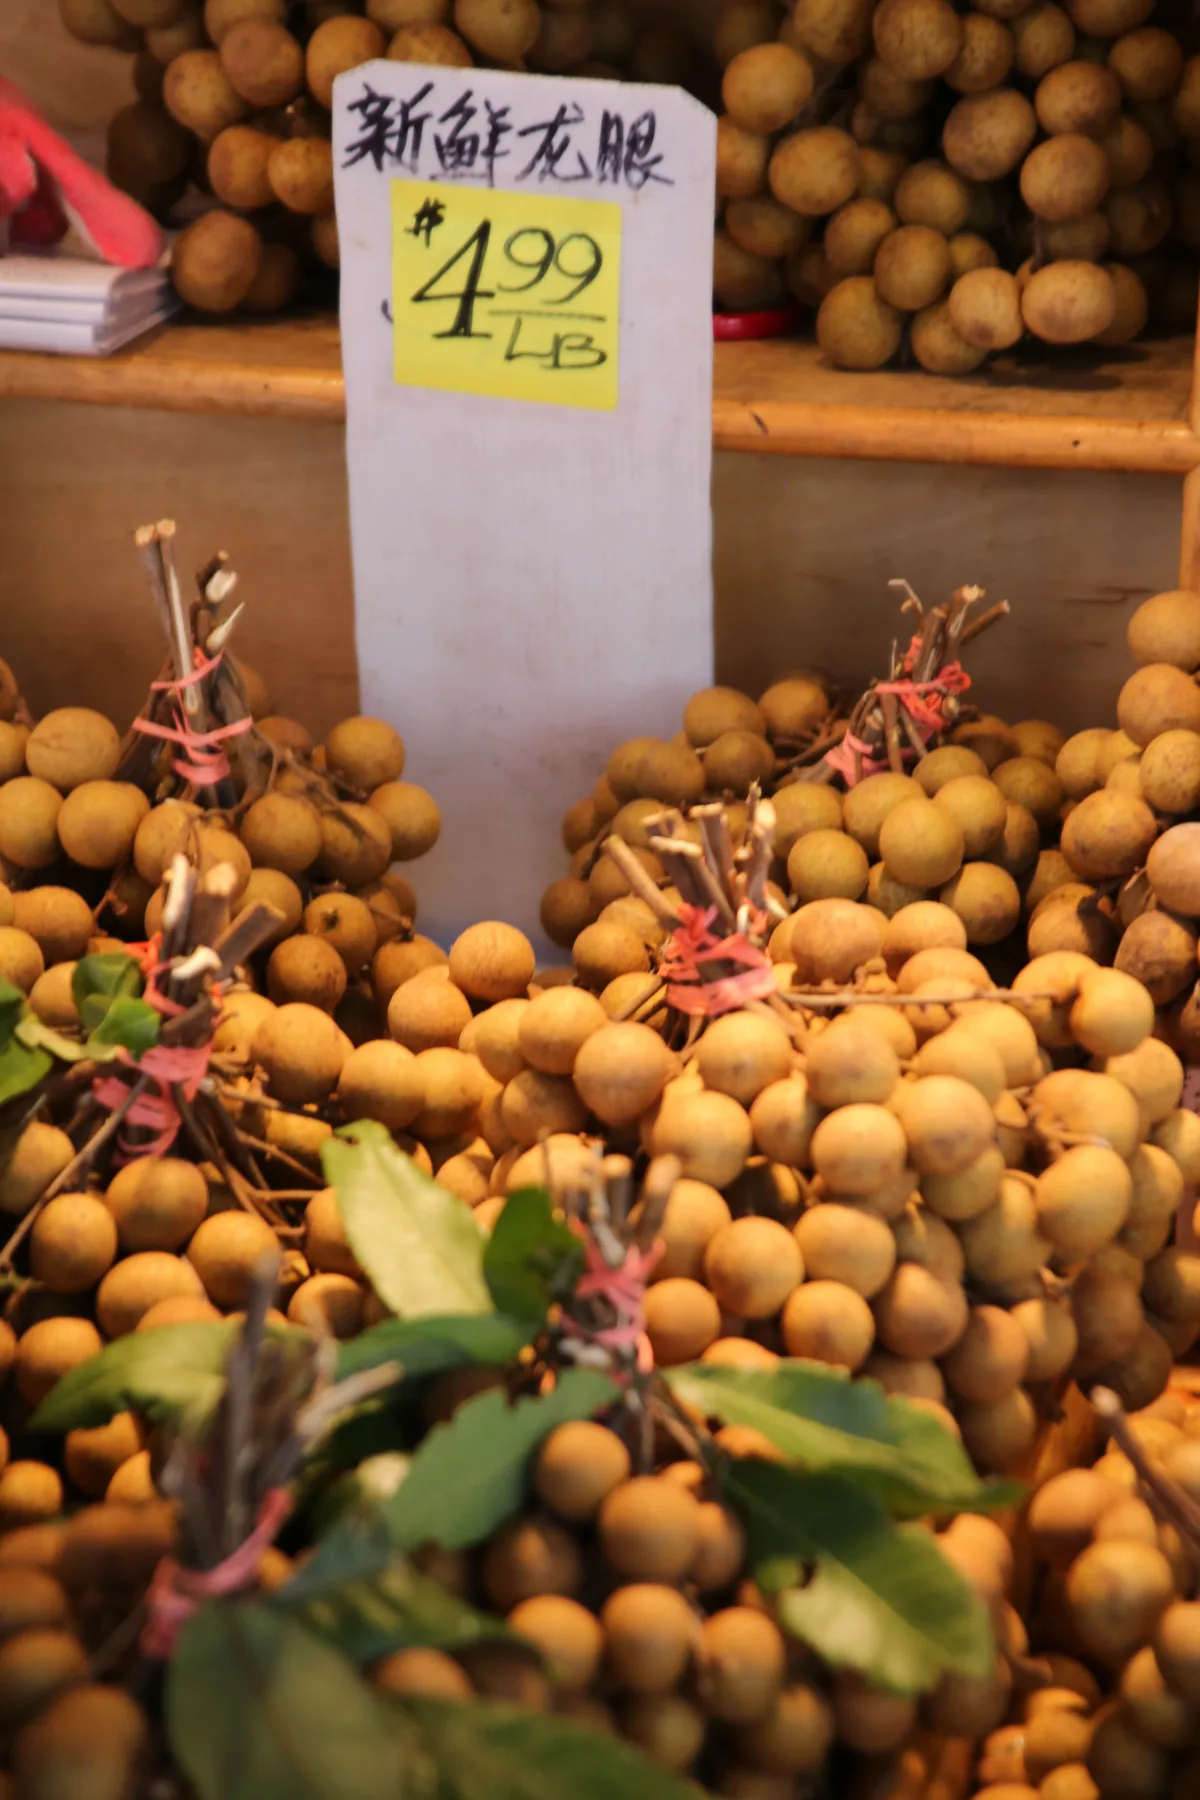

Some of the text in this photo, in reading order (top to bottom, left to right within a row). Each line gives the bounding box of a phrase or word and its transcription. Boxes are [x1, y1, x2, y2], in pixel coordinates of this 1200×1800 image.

[341, 82, 674, 189] 新鲜龙眼
[504, 317, 607, 370] LB
